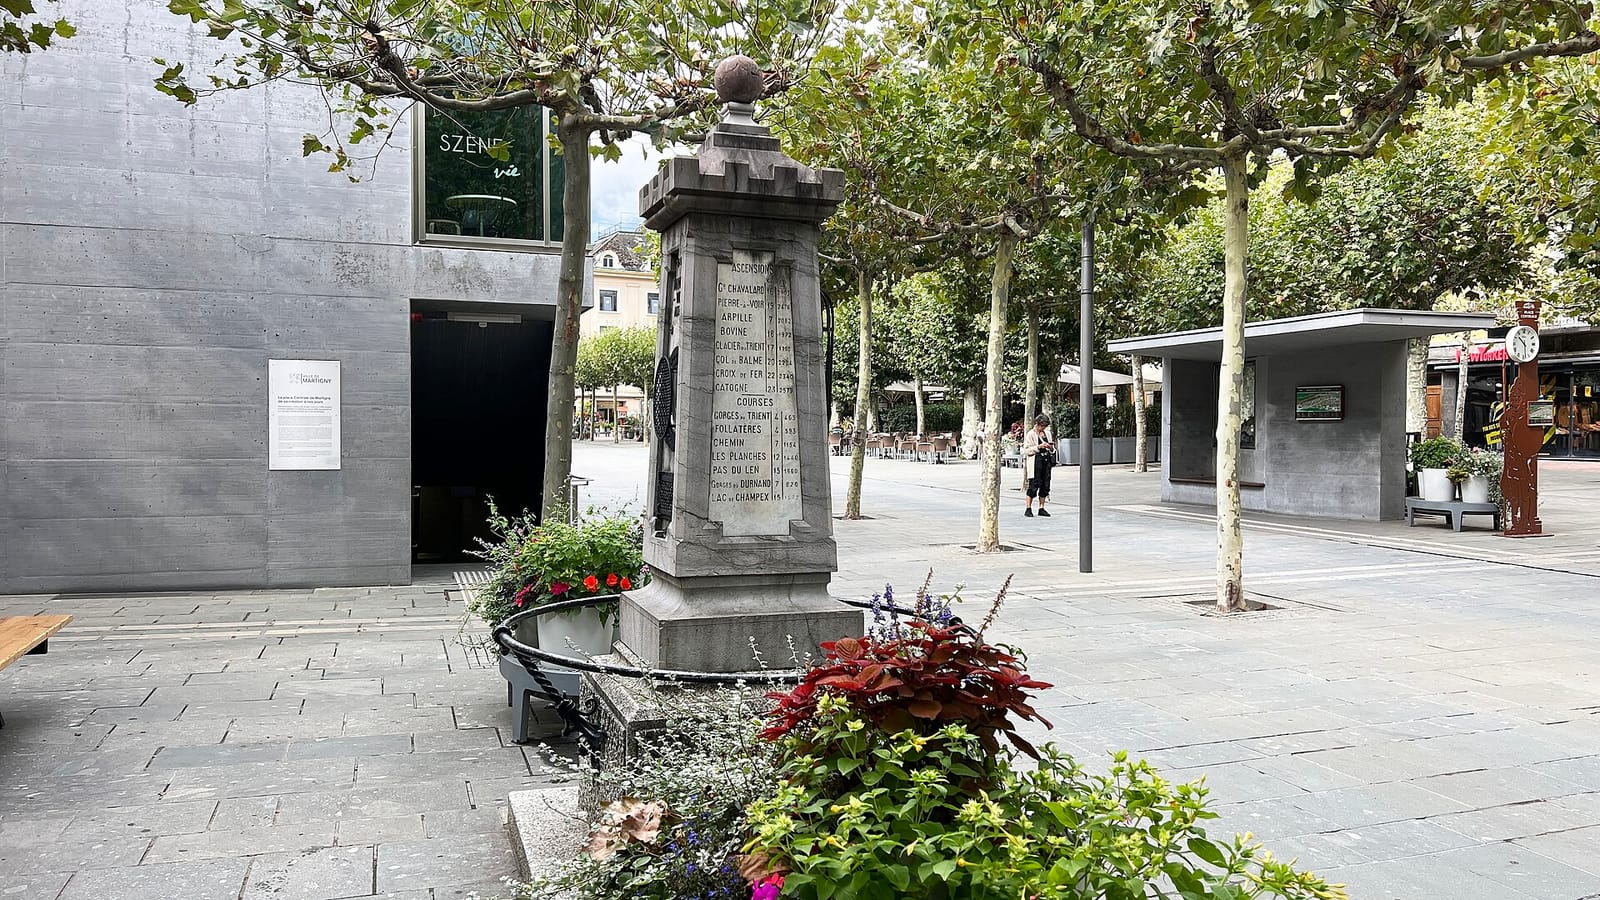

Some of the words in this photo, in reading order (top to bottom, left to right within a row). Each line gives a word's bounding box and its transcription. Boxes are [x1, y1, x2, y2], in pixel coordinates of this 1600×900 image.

[732, 263, 774, 274] ASCENSIONS
[728, 284, 764, 295] CHAVALARD
[722, 314, 752, 322] ARPILLE
[720, 327, 747, 336] BOVINE
[746, 342, 765, 351] TRIENT
[716, 355, 728, 364] COL
[739, 356, 762, 364] BALME
[716, 370, 736, 378] CROIX
[716, 383, 748, 392] CATOGNE
[737, 398, 773, 406] COURSES
[714, 412, 739, 420] GORGES
[748, 412, 770, 420] TRIENT
[714, 438, 744, 447] CHEMIN
[712, 452, 725, 461] LES
[730, 452, 766, 461] PLANCHES
[713, 466, 727, 474] PAS
[732, 466, 742, 474] DU
[745, 466, 759, 474] LEN
[740, 480, 770, 488] DURNAND
[712, 494, 726, 502] LAC
[736, 493, 769, 502] CHAMPEX
